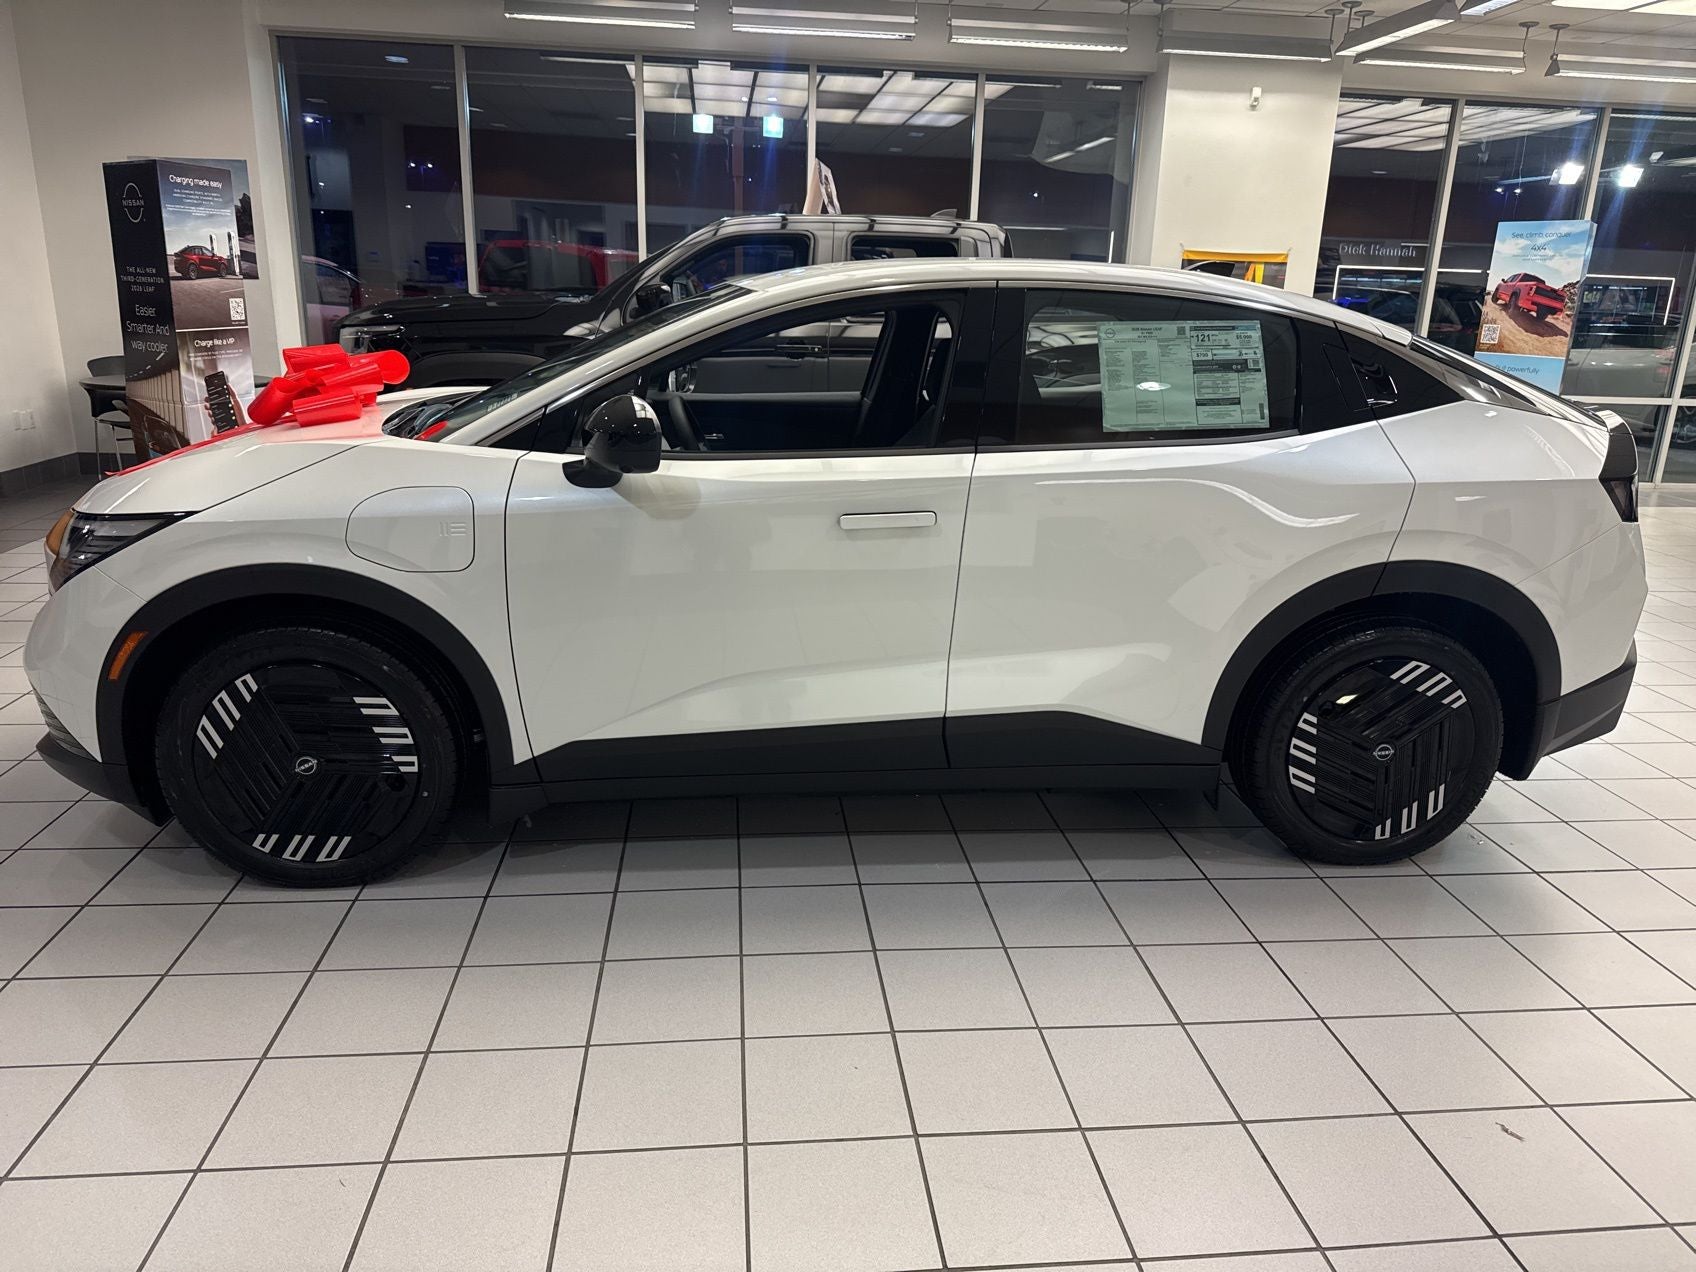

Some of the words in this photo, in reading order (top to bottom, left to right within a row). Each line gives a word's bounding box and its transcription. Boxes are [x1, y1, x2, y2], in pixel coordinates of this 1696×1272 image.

[169, 174, 194, 186] Charging
[194, 179, 210, 187] made
[210, 181, 223, 189] easy
[121, 199, 145, 207] NISSAN
[1530, 243, 1548, 252] 4x4
[120, 275, 165, 284] THIRD-GENERATION
[155, 323, 170, 336] And
[1195, 333, 1211, 342] 121
[131, 340, 146, 353] way
[194, 339, 213, 348] Charge
[213, 338, 223, 346] like
[1507, 366, 1540, 375] powerfully
